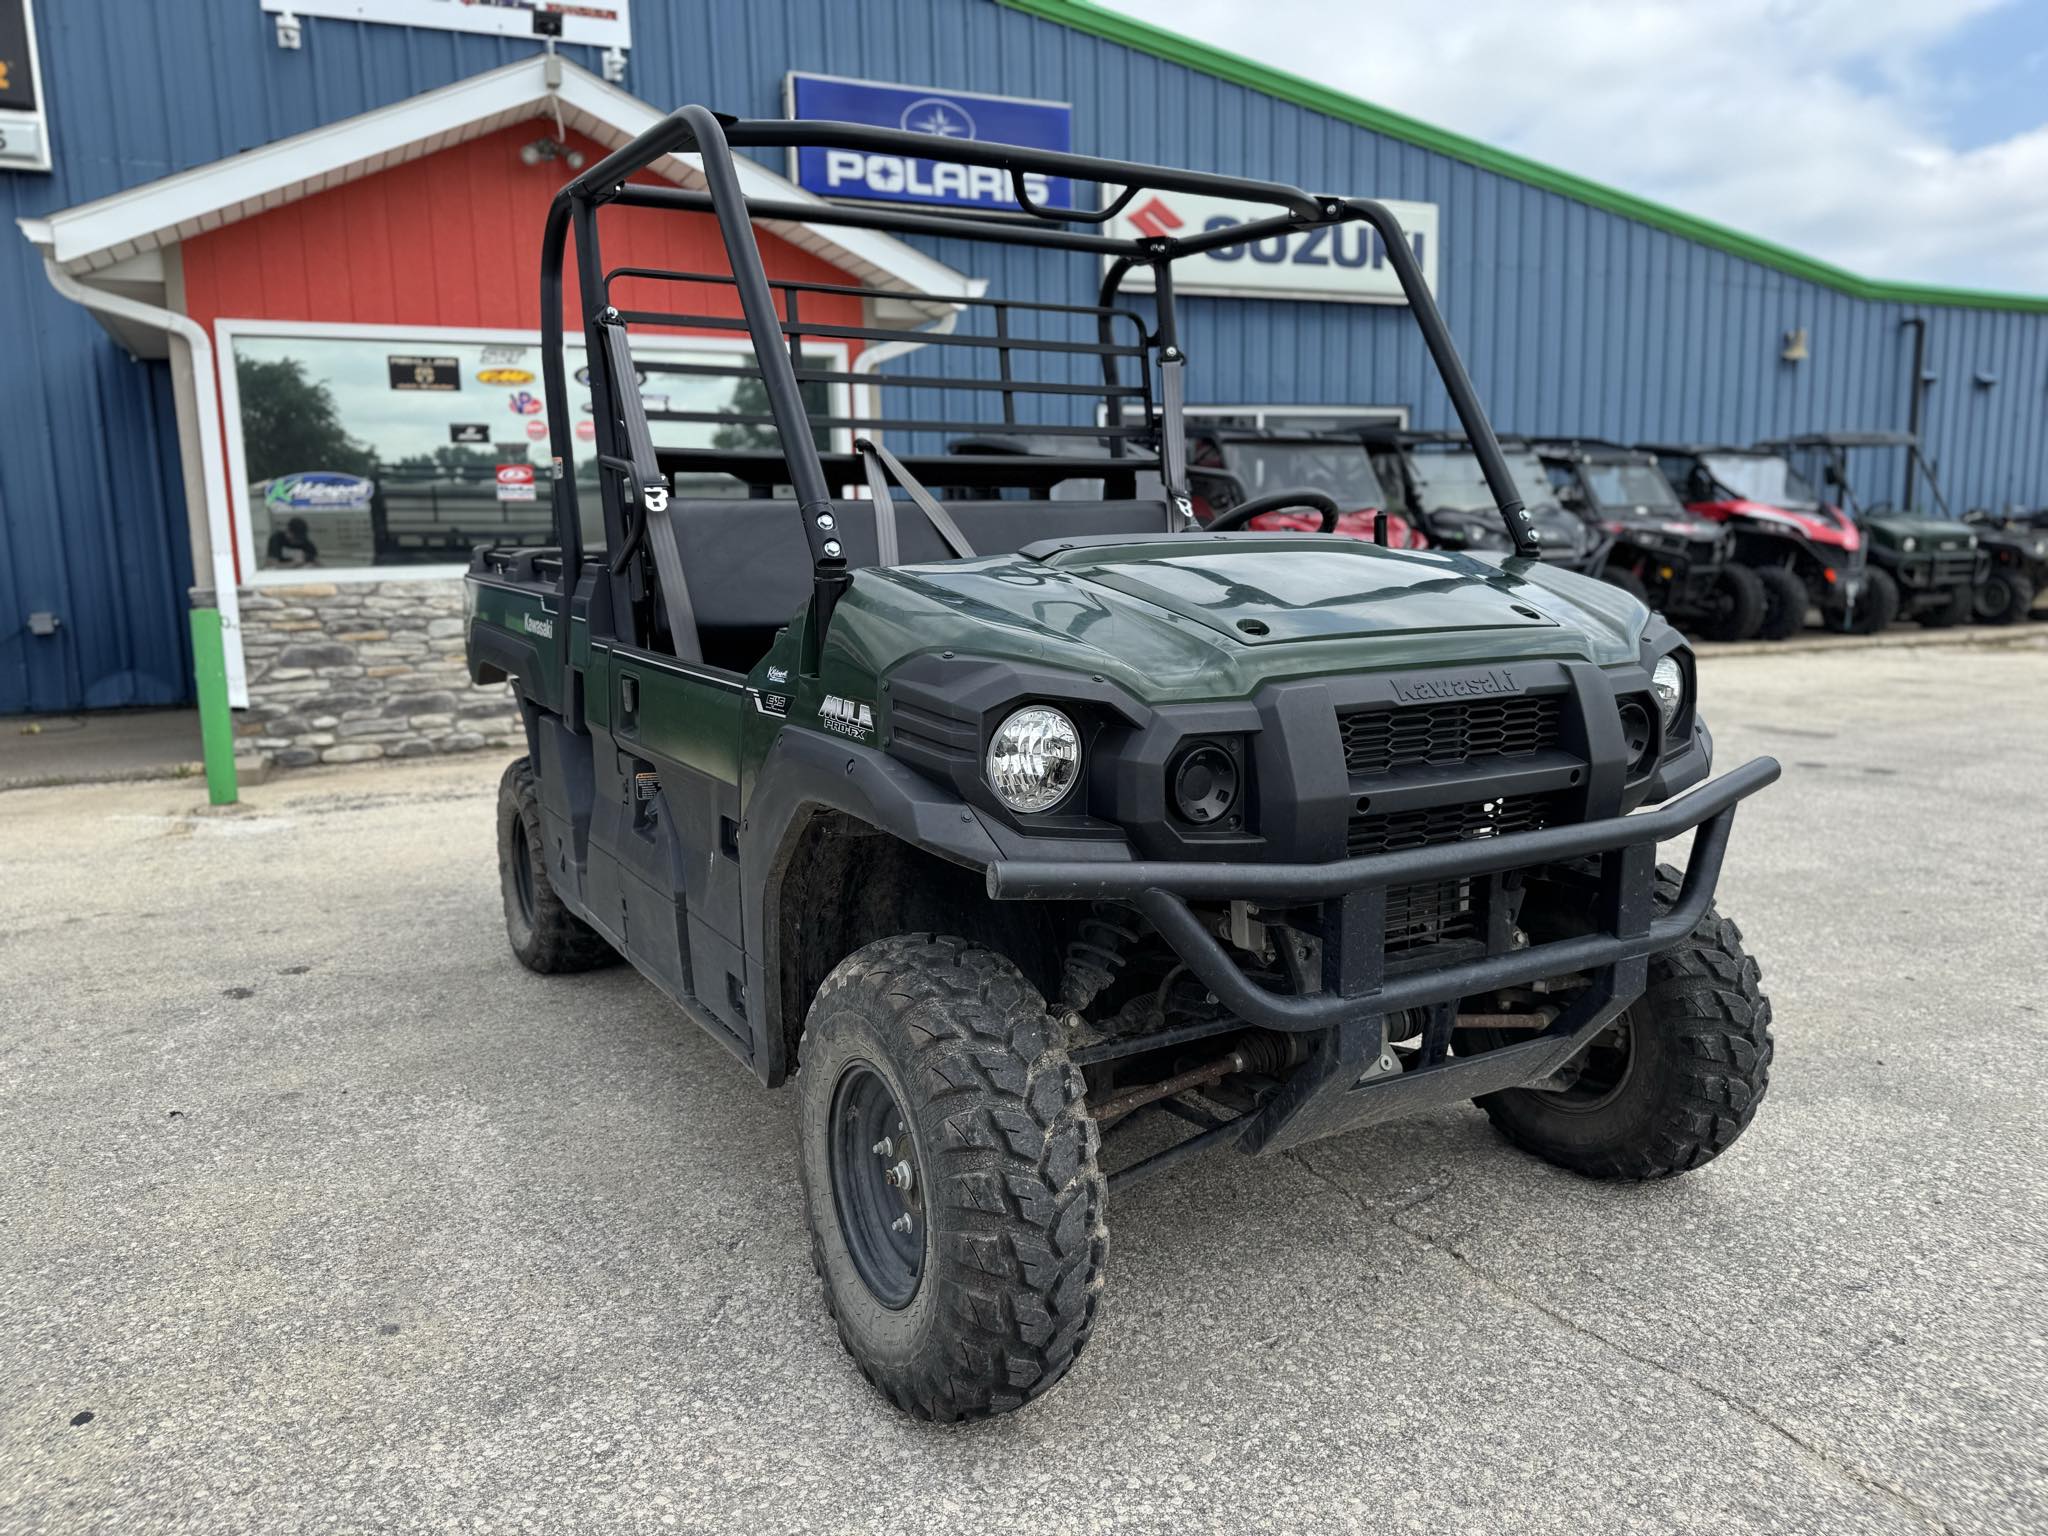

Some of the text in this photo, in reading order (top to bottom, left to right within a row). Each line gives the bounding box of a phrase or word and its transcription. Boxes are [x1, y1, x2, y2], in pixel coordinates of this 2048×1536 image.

[826, 150, 1049, 207] POLARIS
[524, 612, 553, 639] Kawasaki
[1388, 669, 1521, 702] Kawasaki
[818, 694, 875, 732] MULE
